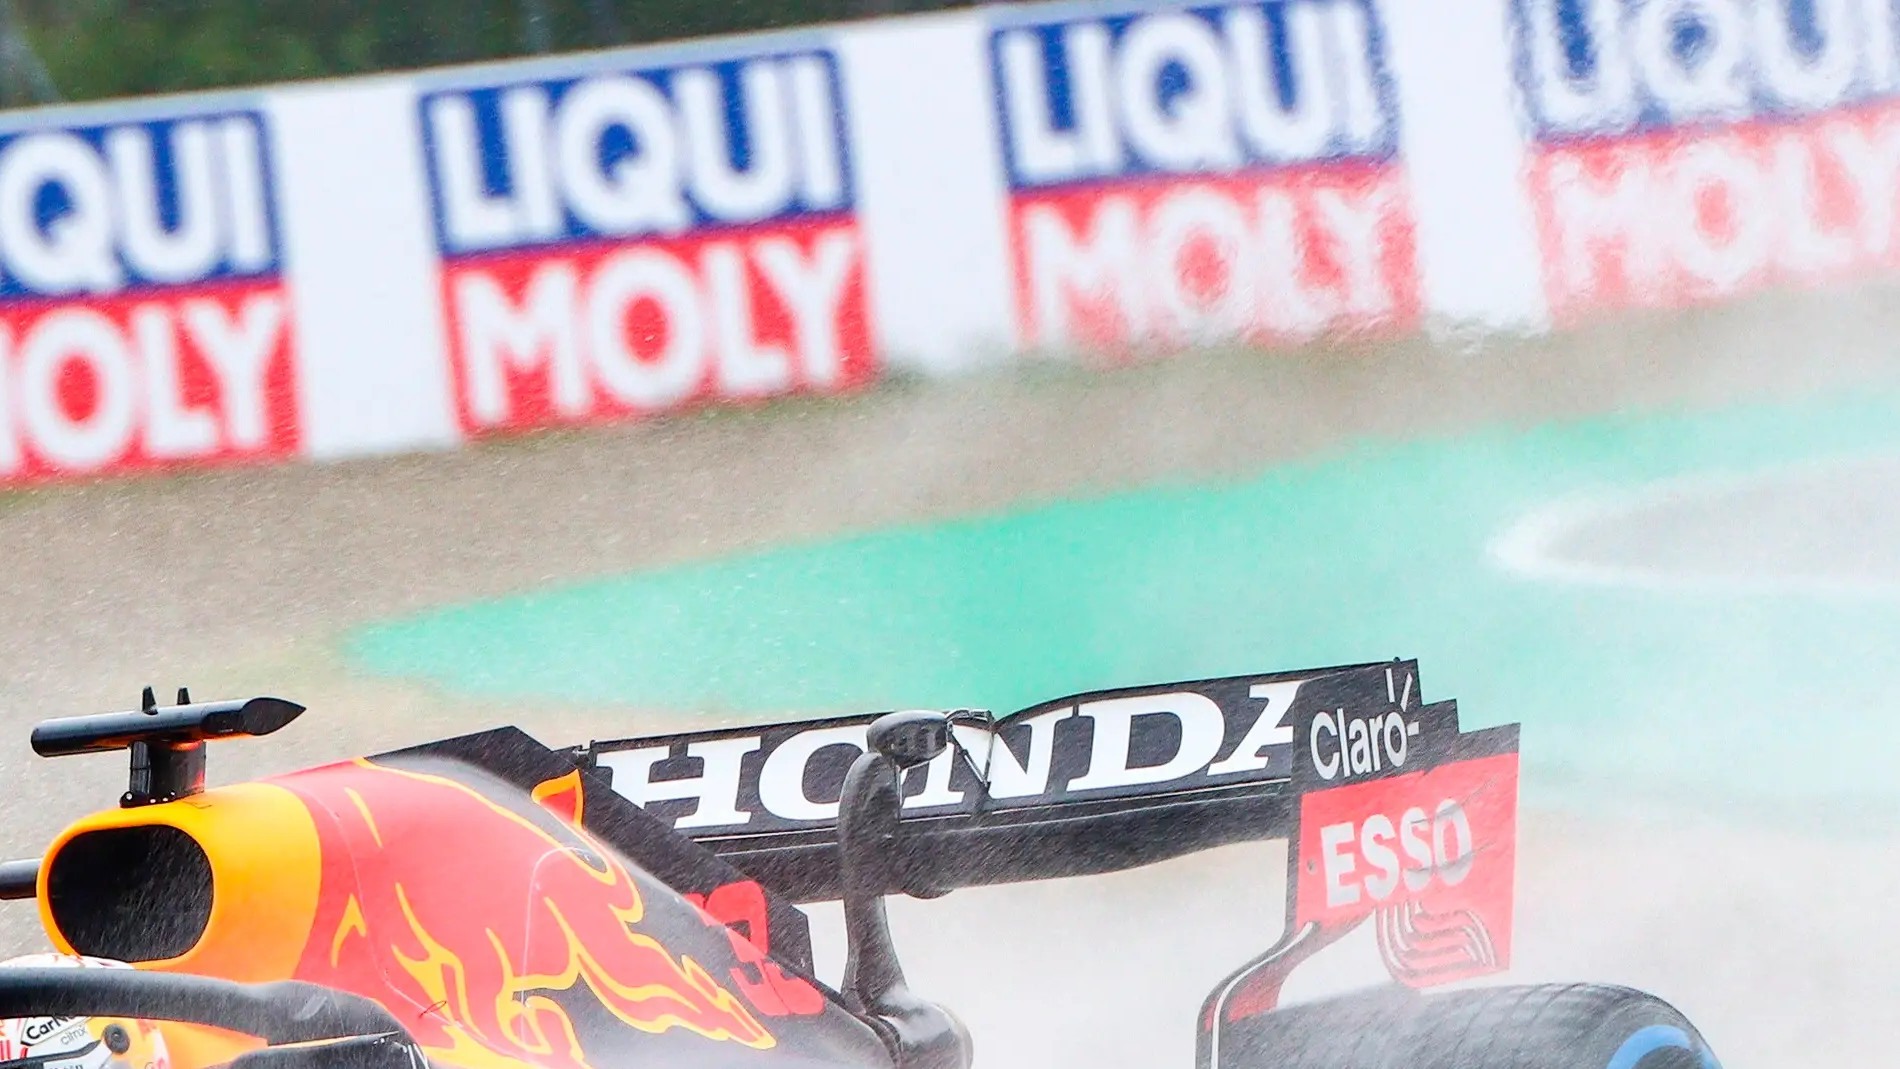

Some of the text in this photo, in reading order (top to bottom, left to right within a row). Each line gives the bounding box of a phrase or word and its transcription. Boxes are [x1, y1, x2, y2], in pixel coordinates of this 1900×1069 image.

[429, 54, 840, 251] LIQUI
[1004, 2, 1381, 176] LIQUI
[453, 230, 856, 424] MOLY
[1026, 180, 1394, 343] MOLY
[1310, 708, 1407, 780] Claro
[1320, 799, 1472, 908] ESSO
